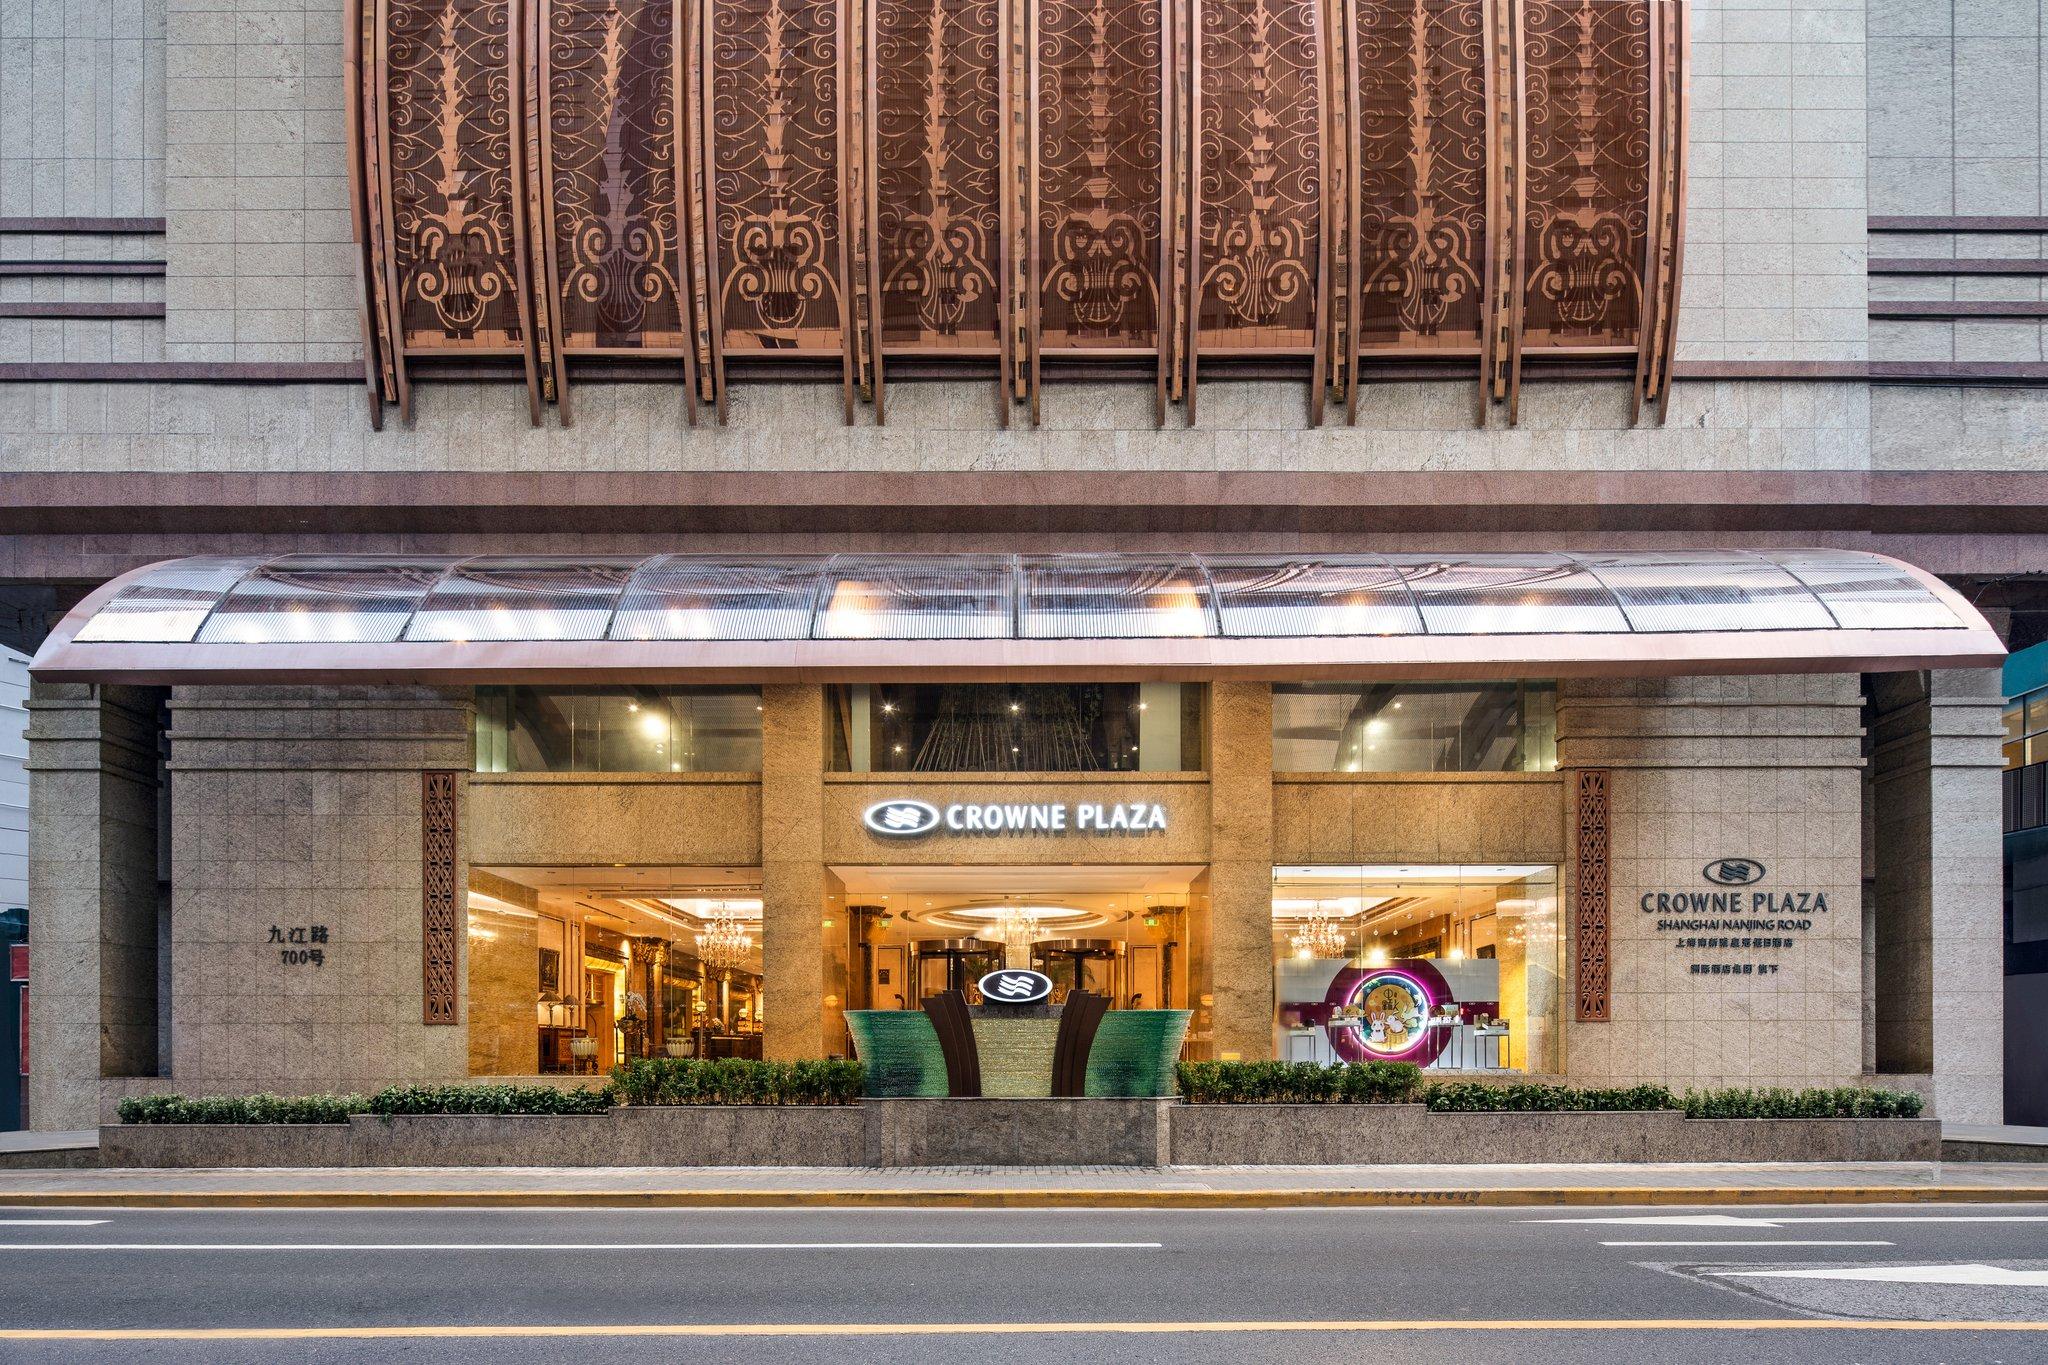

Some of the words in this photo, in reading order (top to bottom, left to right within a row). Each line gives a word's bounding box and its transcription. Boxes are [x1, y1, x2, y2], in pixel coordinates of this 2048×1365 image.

[946, 803, 1066, 830] CROWNE
[1077, 803, 1167, 830] PLAZA
[1641, 892, 1742, 914] CROWNE
[1753, 892, 1829, 914] PLAZA
[267, 925, 329, 944] 九江路
[1657, 919, 1719, 931] SHANGHAI
[1722, 919, 1775, 932] NANJING
[1778, 919, 1812, 931] ROAD
[281, 949, 325, 967] 700号
